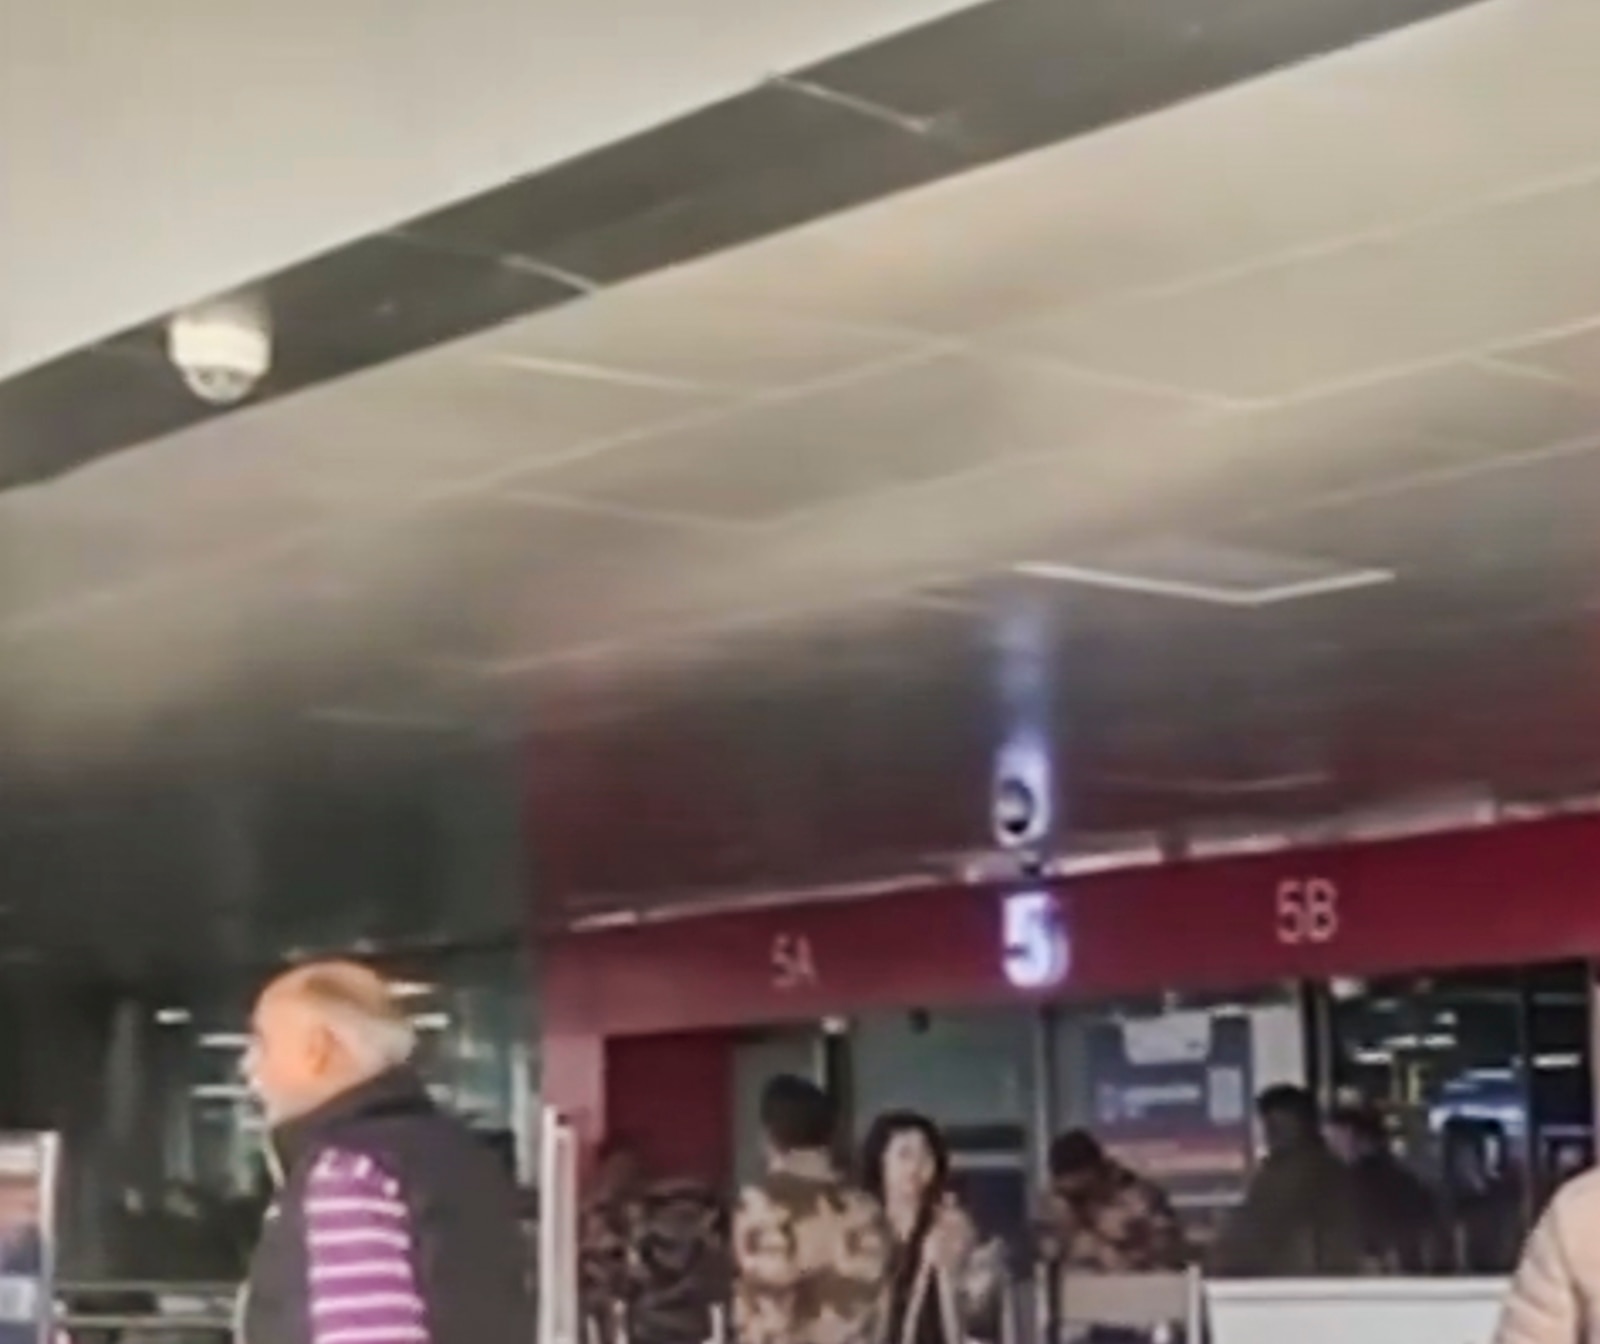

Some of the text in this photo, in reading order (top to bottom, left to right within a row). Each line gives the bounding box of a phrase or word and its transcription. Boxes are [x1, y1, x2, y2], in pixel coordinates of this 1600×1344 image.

[1003, 890, 1066, 989] 5
[1275, 878, 1338, 944] 5B
[770, 934, 818, 988] 5A
